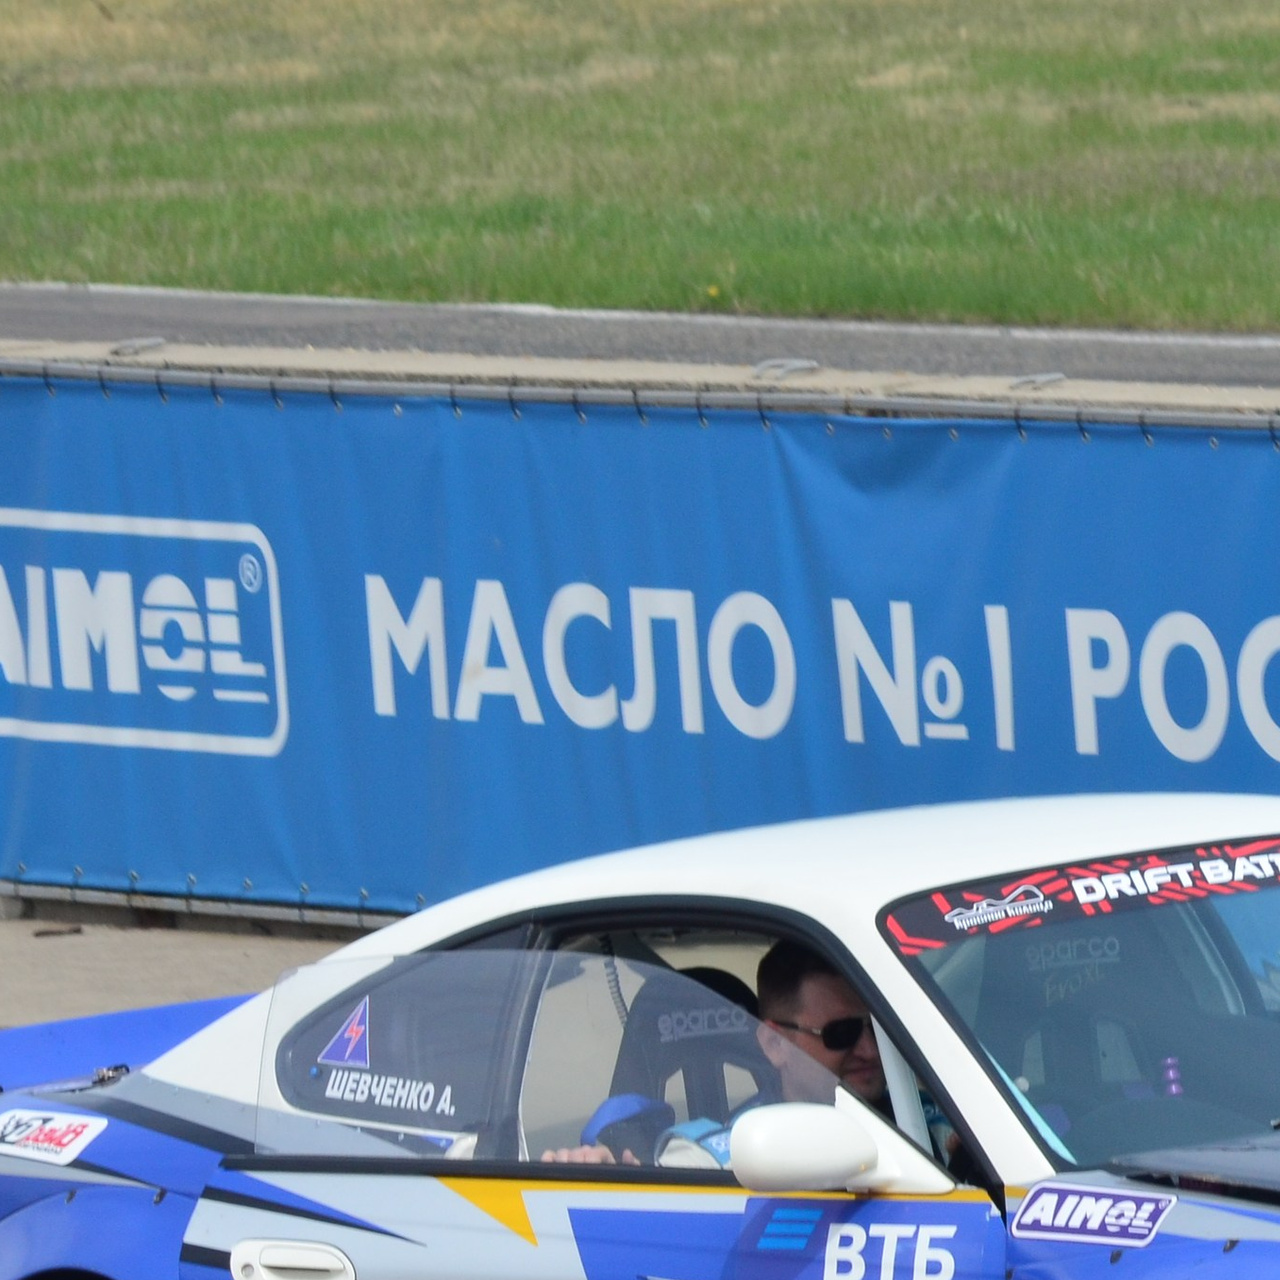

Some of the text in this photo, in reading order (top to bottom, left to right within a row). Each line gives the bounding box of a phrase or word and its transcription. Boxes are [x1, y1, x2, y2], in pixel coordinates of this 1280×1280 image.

[365, 574, 797, 740] МАСЛО
[1072, 862, 1194, 904] DRIFT
[1025, 936, 1120, 971] sparco
[658, 1006, 748, 1042] sparco
[325, 1068, 455, 1116] ШЕВЧЕНКО А.
